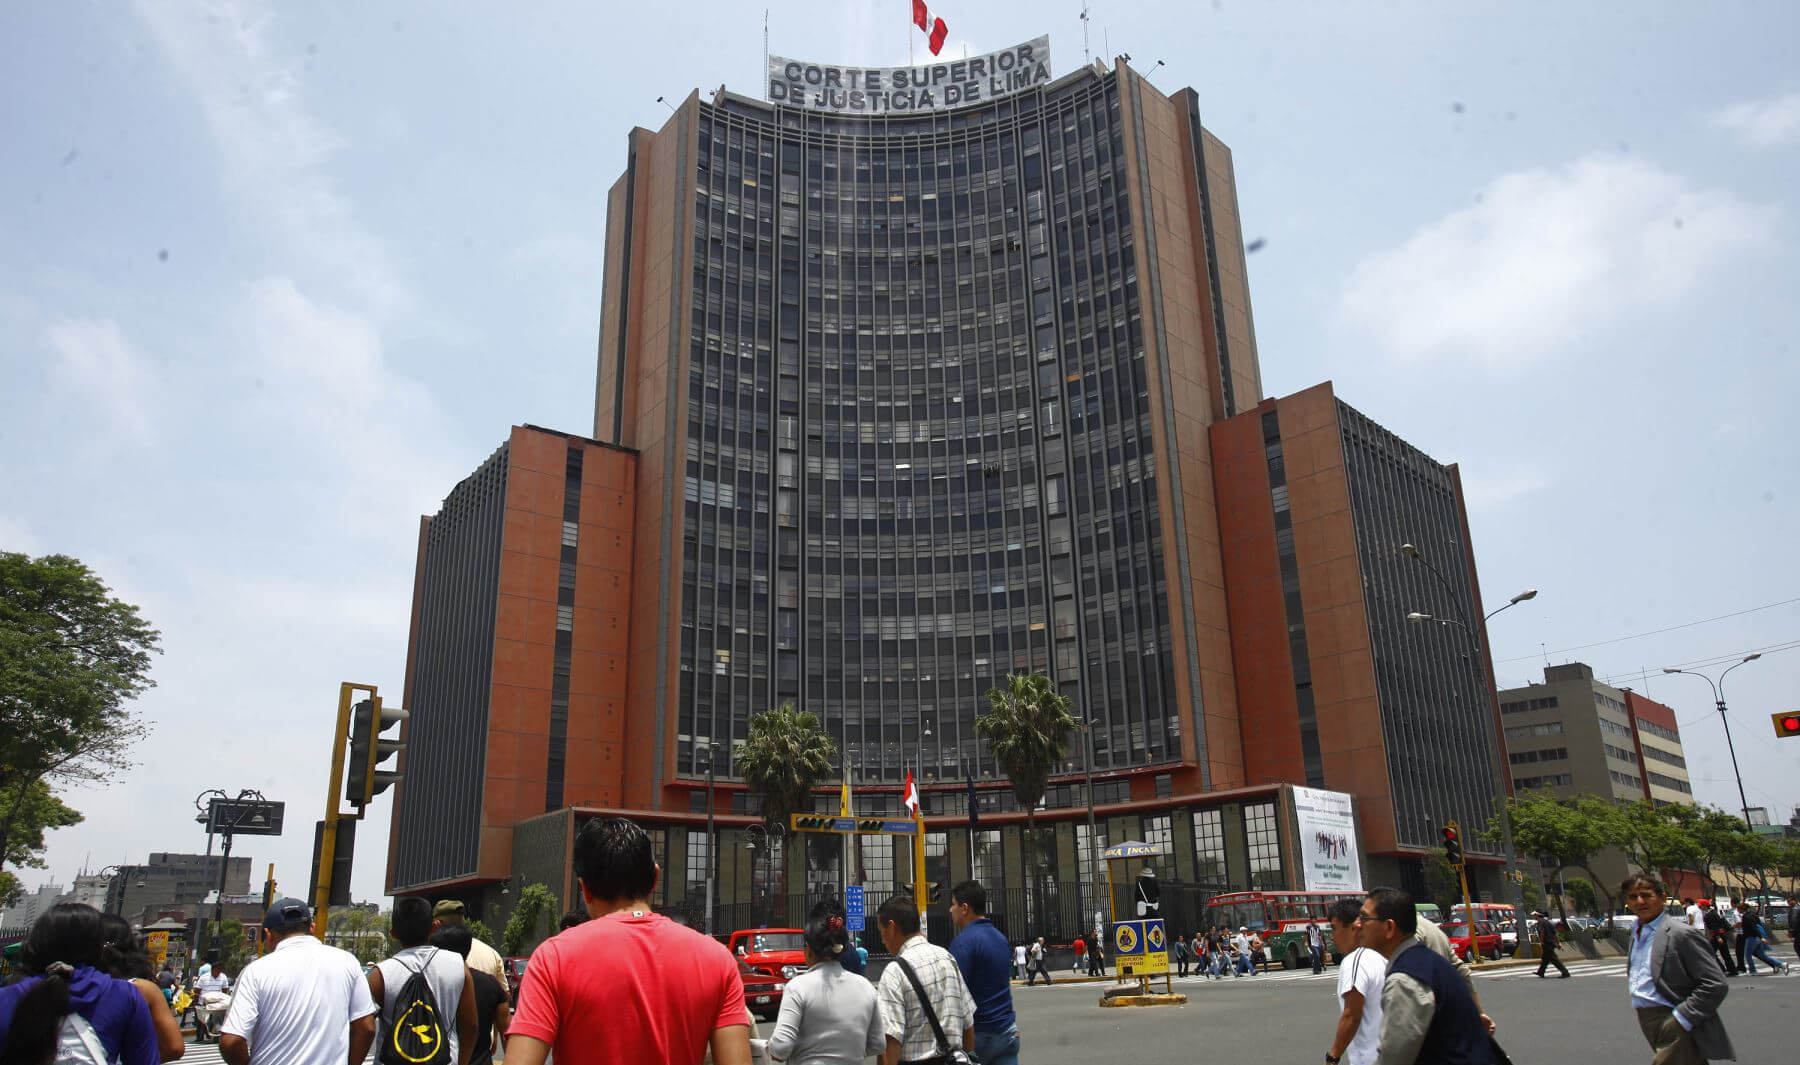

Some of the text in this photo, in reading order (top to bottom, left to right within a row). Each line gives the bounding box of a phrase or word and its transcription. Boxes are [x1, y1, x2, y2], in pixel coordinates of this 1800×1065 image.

[770, 61, 1050, 112] DE JUSTICIA DE LIMA
[784, 44, 1036, 90] CORTE SUPERIOR
